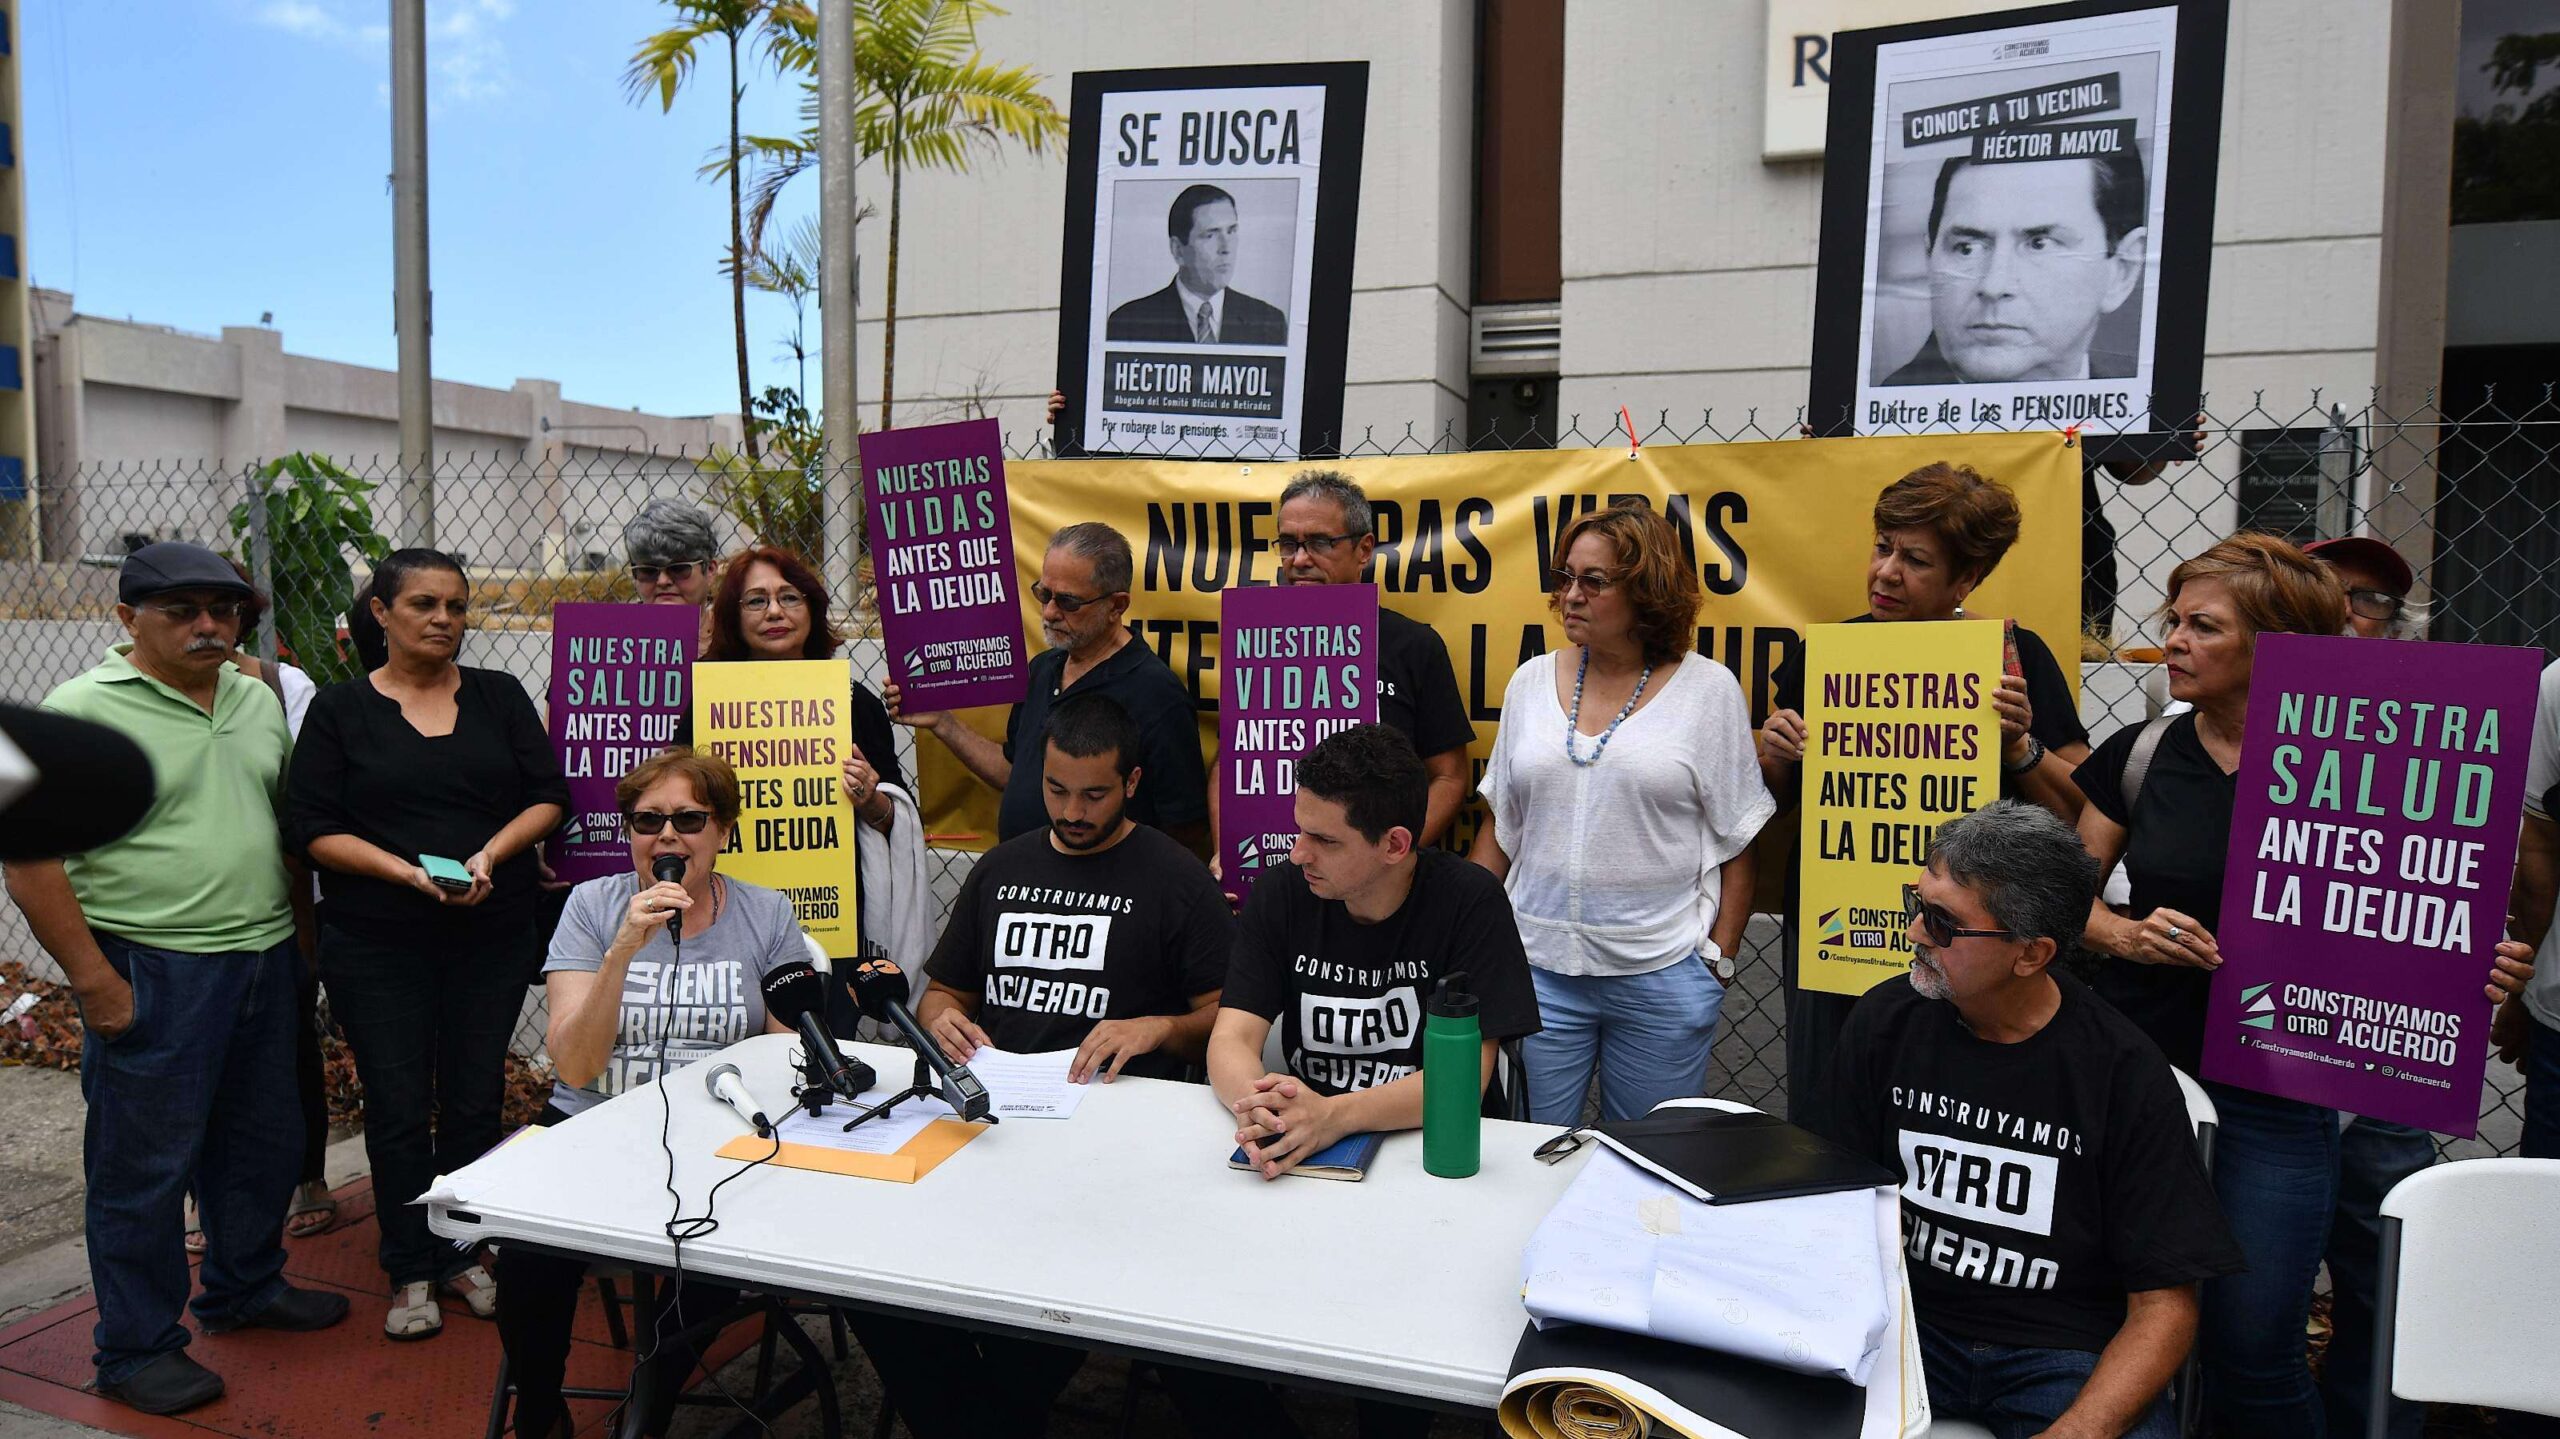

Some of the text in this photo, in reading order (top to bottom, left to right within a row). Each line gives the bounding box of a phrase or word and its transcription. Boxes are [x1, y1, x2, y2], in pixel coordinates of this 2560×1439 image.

[1911, 82, 2108, 140] CONOCE A TU VECINO.
[1118, 109, 1300, 167] SE BUSCA
[1982, 128, 2122, 160] HÉCTOR MAYOL
[1115, 358, 1272, 396] HÉCTOR MAYOL
[1114, 395, 1144, 407] Abogado
[1148, 396, 1159, 406] del
[1192, 398, 1218, 409] Oficial
[1221, 399, 1230, 409] de
[1233, 399, 1271, 411] Retirados
[1938, 398, 1960, 422] de
[1971, 398, 2001, 421] las
[2012, 392, 2134, 421] PENSIONES.
[1102, 417, 1116, 431] Por
[1121, 419, 1157, 435] robarse
[1161, 421, 1176, 436] las
[877, 455, 991, 495] NUESTRAS
[880, 490, 996, 540] VIDAS
[888, 536, 1001, 577] ANTES QUE
[891, 571, 1006, 615] LA DEUDA
[569, 637, 684, 665] NUESTRA
[924, 635, 1011, 659] CONSTRUYAMOS
[1235, 624, 1361, 659] NUESTRAS
[929, 650, 1013, 673] OTRO ACUERDO
[567, 669, 683, 708] SALUD
[1234, 664, 1361, 710] VIDAS
[1823, 673, 1980, 709] NUESTRAS
[565, 712, 631, 742] ANTES
[710, 698, 836, 730] NUESTRAS
[2276, 692, 2500, 755] NUESTRA
[710, 737, 836, 768] PENSIONES
[1234, 718, 1306, 752] ANTES
[1822, 722, 1979, 760] PENSIONES
[564, 746, 593, 779] LA
[1235, 759, 1265, 795] LA
[793, 777, 838, 808] QUE
[1819, 771, 1977, 813] ANTES QUE
[2268, 744, 2494, 828] SALUD
[589, 830, 612, 842] OTRO
[755, 816, 839, 852] DEUDA
[1820, 820, 1940, 866] LA DEU
[2257, 816, 2486, 890] ANTES QUE
[997, 885, 1134, 914] CONSTRUYAMOS
[2251, 870, 2472, 954] LA DEUDA
[1004, 921, 1094, 960] OTRO
[1852, 931, 1883, 946] OTRO
[622, 960, 745, 1005] LA GENTE
[985, 973, 1110, 1019] ACUERDO
[1312, 997, 1409, 1048] OTRO
[2283, 983, 2461, 1038] CONSTRUYAMOS
[2287, 1015, 2457, 1066] OTRO ACUERDO
[2251, 1039, 2355, 1069] /ConstruyamosOtroAcuerdo
[2395, 1069, 2451, 1089] /otroacuerdo
[1892, 1086, 2082, 1156] CONSTRUYAMOS
[1914, 1144, 2032, 1216] OTRO
[1901, 1209, 2059, 1291] CUERDO
